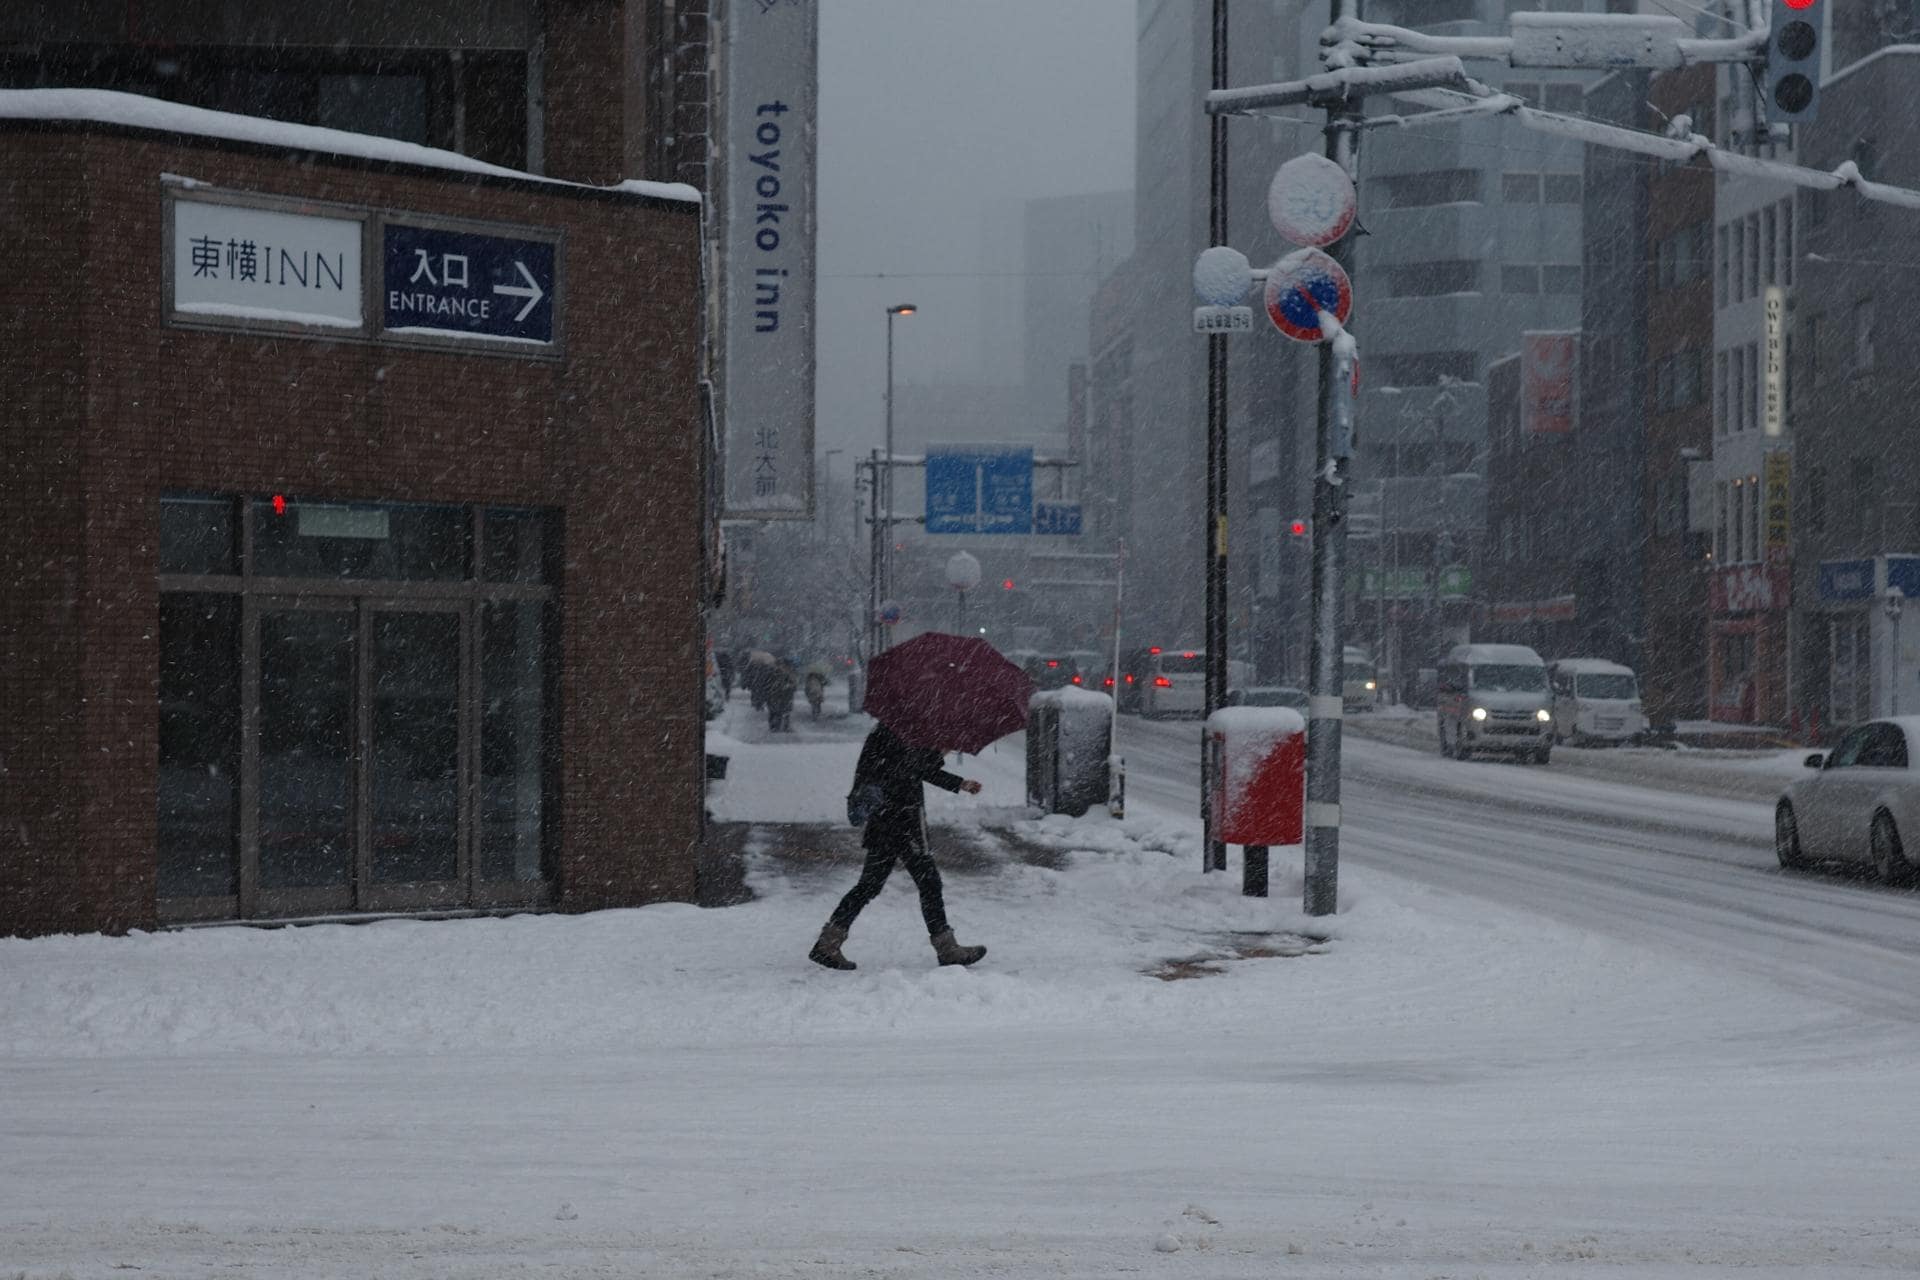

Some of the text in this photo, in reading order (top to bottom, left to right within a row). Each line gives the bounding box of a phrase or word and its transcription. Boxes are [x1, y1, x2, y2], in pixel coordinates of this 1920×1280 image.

[748, 99, 789, 333] toyoko inn
[190, 236, 344, 290] 東横INN
[410, 249, 470, 289] 入口
[390, 290, 490, 318] ENTRANCE
[754, 426, 779, 497] 北大前
